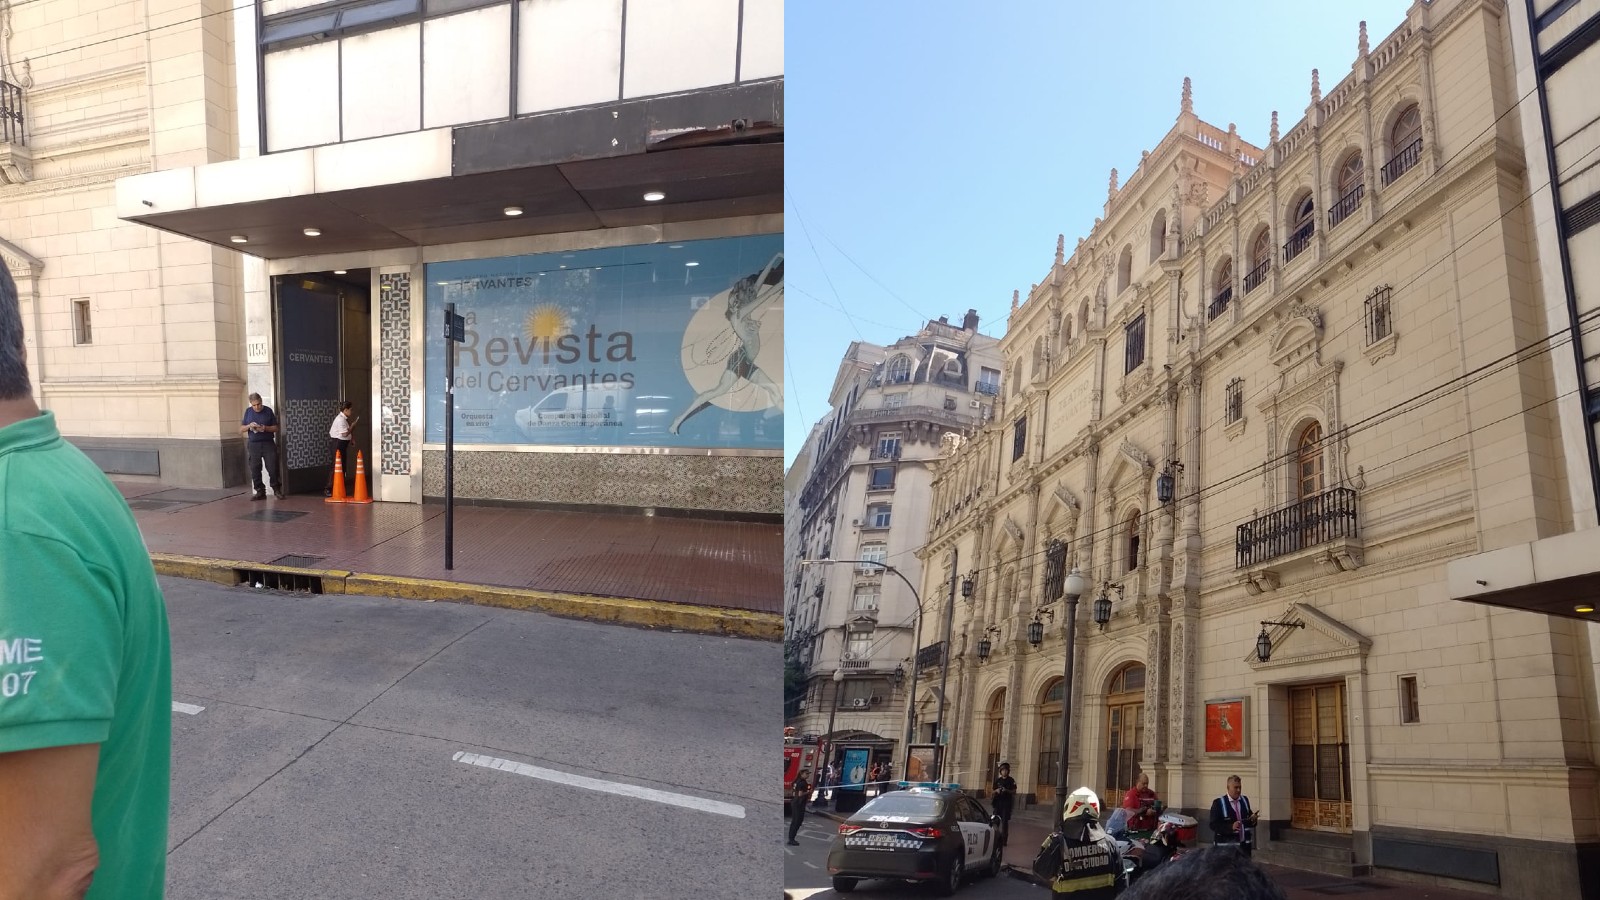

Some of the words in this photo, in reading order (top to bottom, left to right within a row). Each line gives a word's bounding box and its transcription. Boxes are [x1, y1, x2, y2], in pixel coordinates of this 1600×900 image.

[454, 324, 637, 367] Revista
[289, 352, 333, 364] CERVANTES
[454, 372, 482, 388] del
[487, 368, 636, 393] Cervantes
[461, 412, 493, 421] Orquesta
[1063, 844, 1108, 859] OMBEROS
[1083, 855, 1109, 870] CIUDAD
